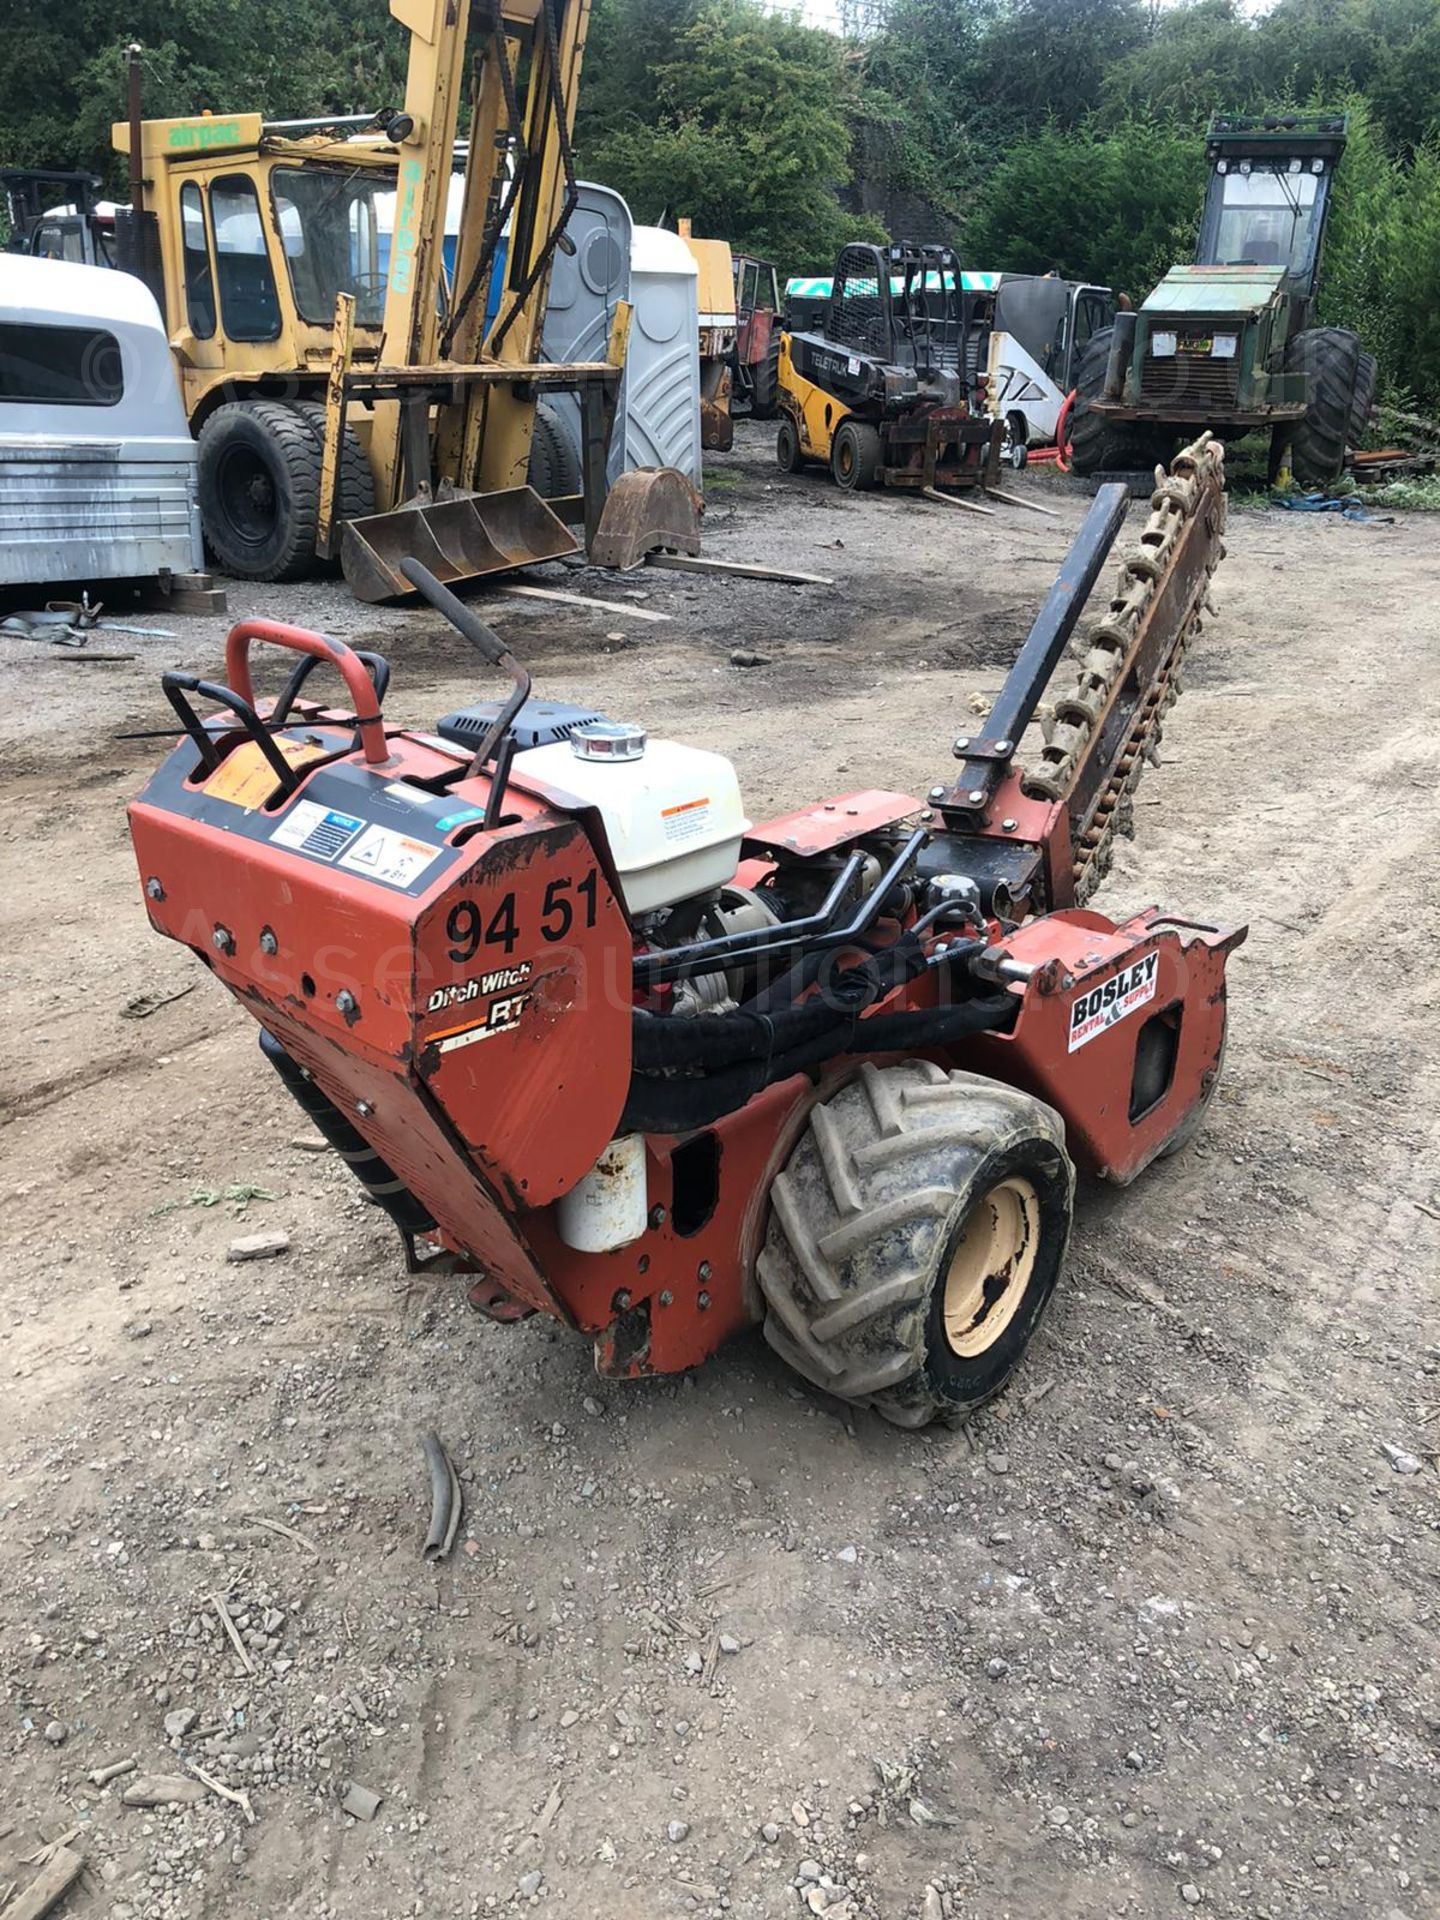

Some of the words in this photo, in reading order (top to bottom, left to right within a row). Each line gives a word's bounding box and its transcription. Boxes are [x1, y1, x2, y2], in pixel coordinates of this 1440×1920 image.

[168, 122, 241, 150] airpac
[811, 351, 848, 377] TELETRUK
[446, 892, 520, 963] 94
[540, 868, 597, 942] 51
[428, 979, 479, 1013] Ditch
[481, 960, 533, 1002] Witch
[1071, 1012, 1105, 1043] RENTAL
[1123, 980, 1154, 1008] SUPPLY
[1072, 952, 1158, 1029] BOSLEY
